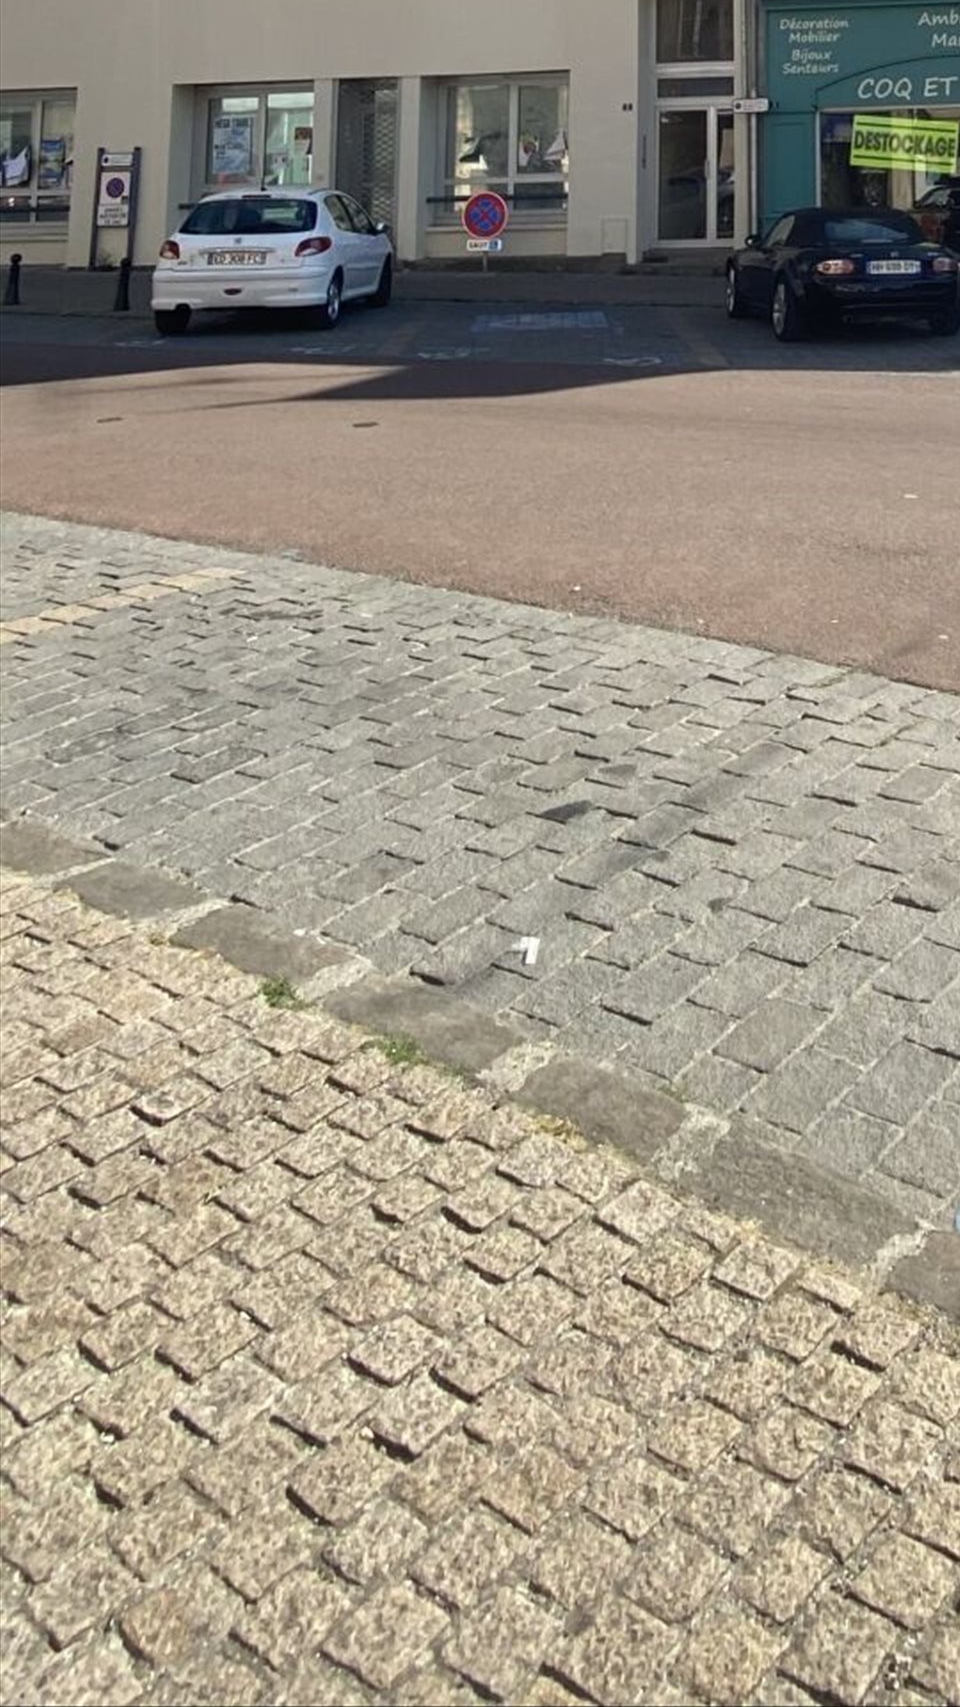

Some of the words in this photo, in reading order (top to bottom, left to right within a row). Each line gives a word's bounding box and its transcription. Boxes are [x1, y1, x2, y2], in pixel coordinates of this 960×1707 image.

[780, 17, 849, 30] Décoration
[789, 30, 840, 44] Mobilier
[792, 48, 832, 64] Bijoux
[782, 62, 840, 75] Senteurs
[857, 77, 912, 100] COQ
[924, 77, 958, 97] ET
[853, 131, 956, 157] DESTOCKAGE
